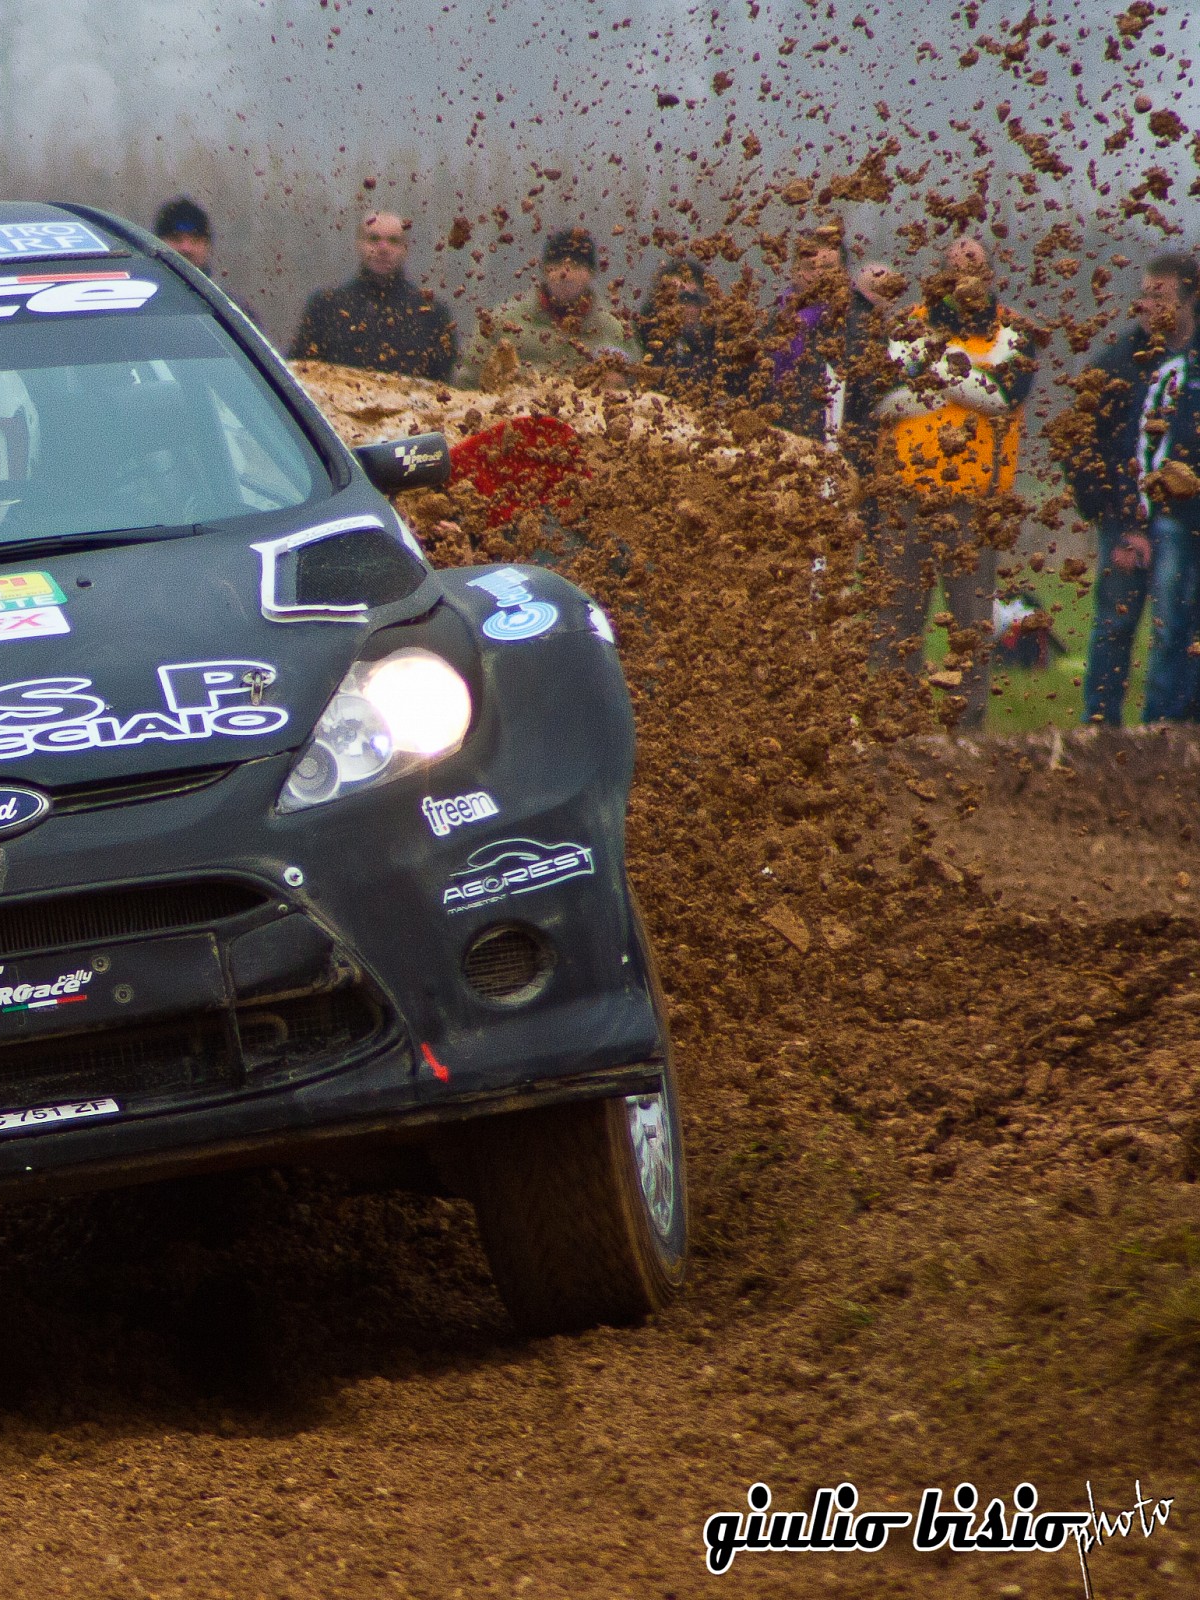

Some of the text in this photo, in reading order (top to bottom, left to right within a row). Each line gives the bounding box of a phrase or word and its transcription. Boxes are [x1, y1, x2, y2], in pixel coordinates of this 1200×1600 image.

[424, 793, 498, 834] freem
[443, 848, 592, 905] AGOREST
[57, 969, 93, 985] rally
[13, 1107, 62, 1123] 751
[70, 1100, 107, 1114] ZF
